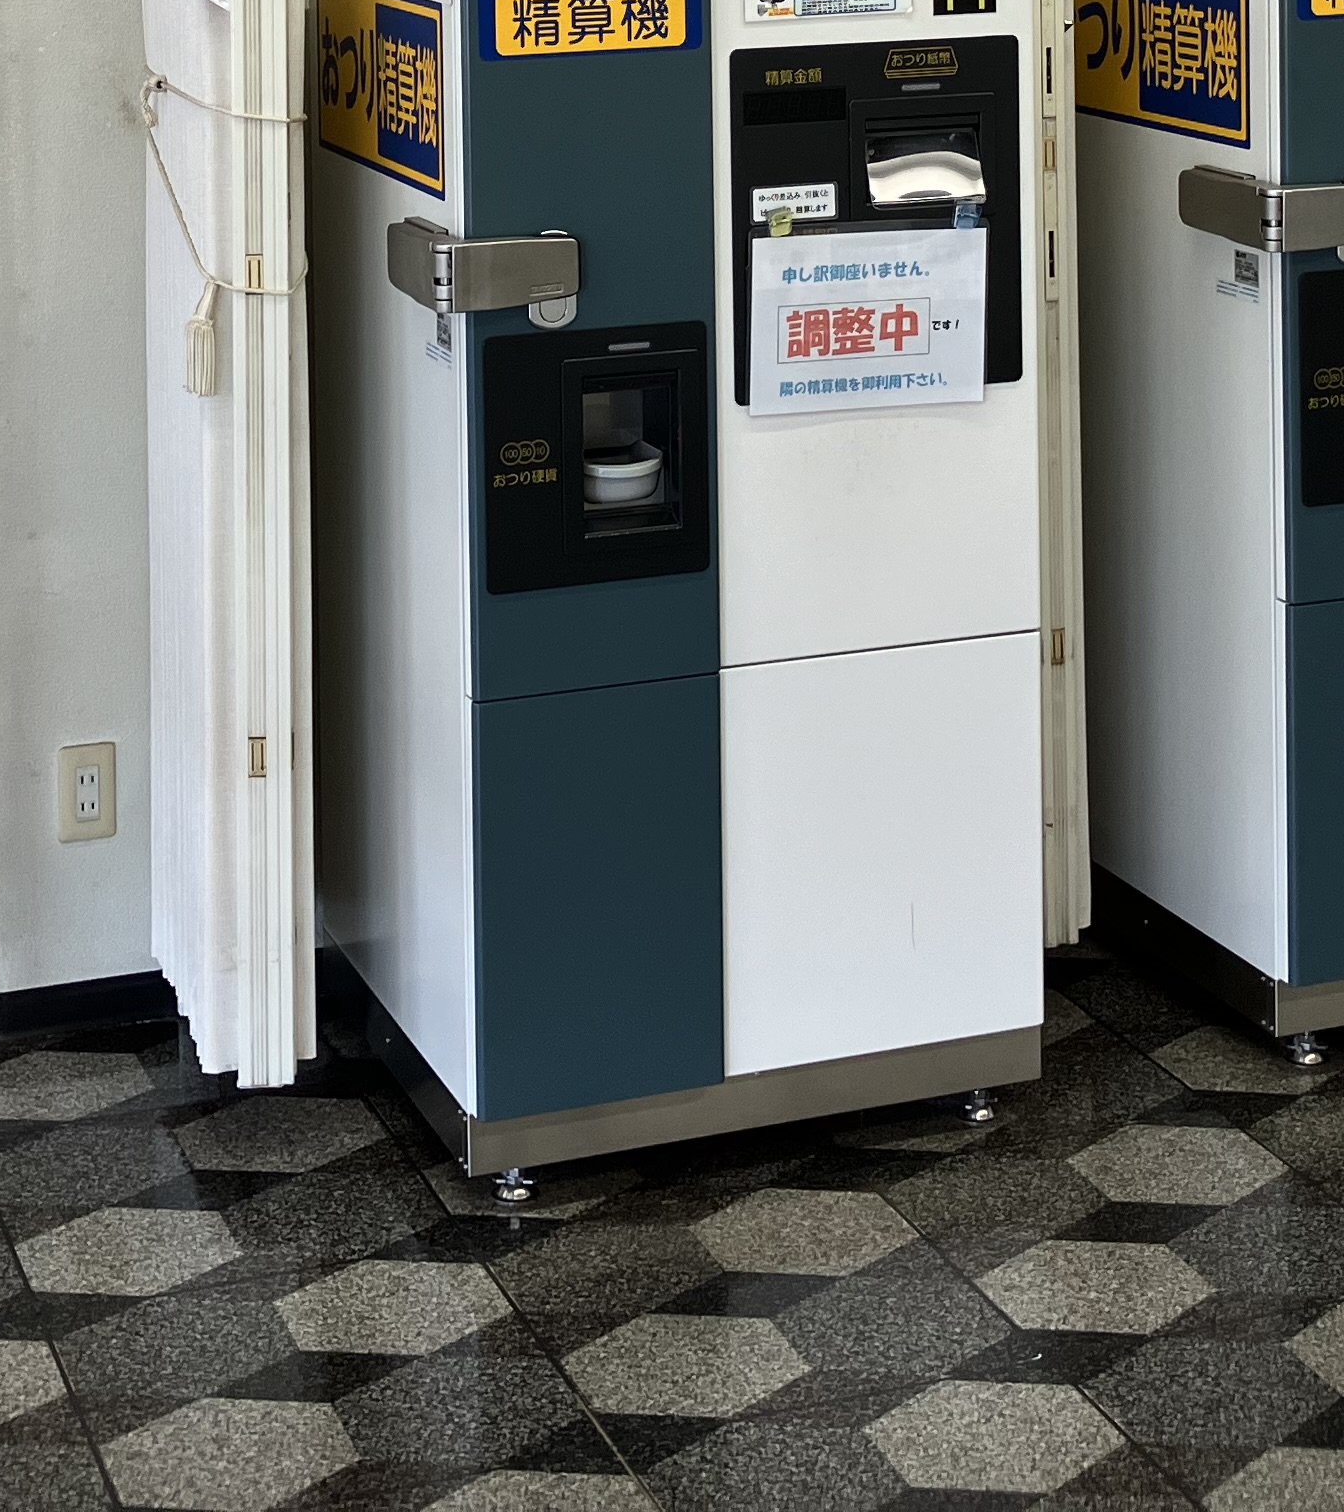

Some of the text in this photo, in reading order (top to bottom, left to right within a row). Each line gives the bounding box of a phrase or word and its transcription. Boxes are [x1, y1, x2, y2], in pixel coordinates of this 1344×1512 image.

[890, 51, 951, 67] おつり紙幣
[765, 68, 823, 86] 精算金額
[782, 261, 930, 284] 申し訳御座いません。
[786, 304, 919, 359] 調整中
[779, 372, 948, 397] 隣の精算機を御利用下さい。
[493, 468, 558, 488] おつり硬貨
